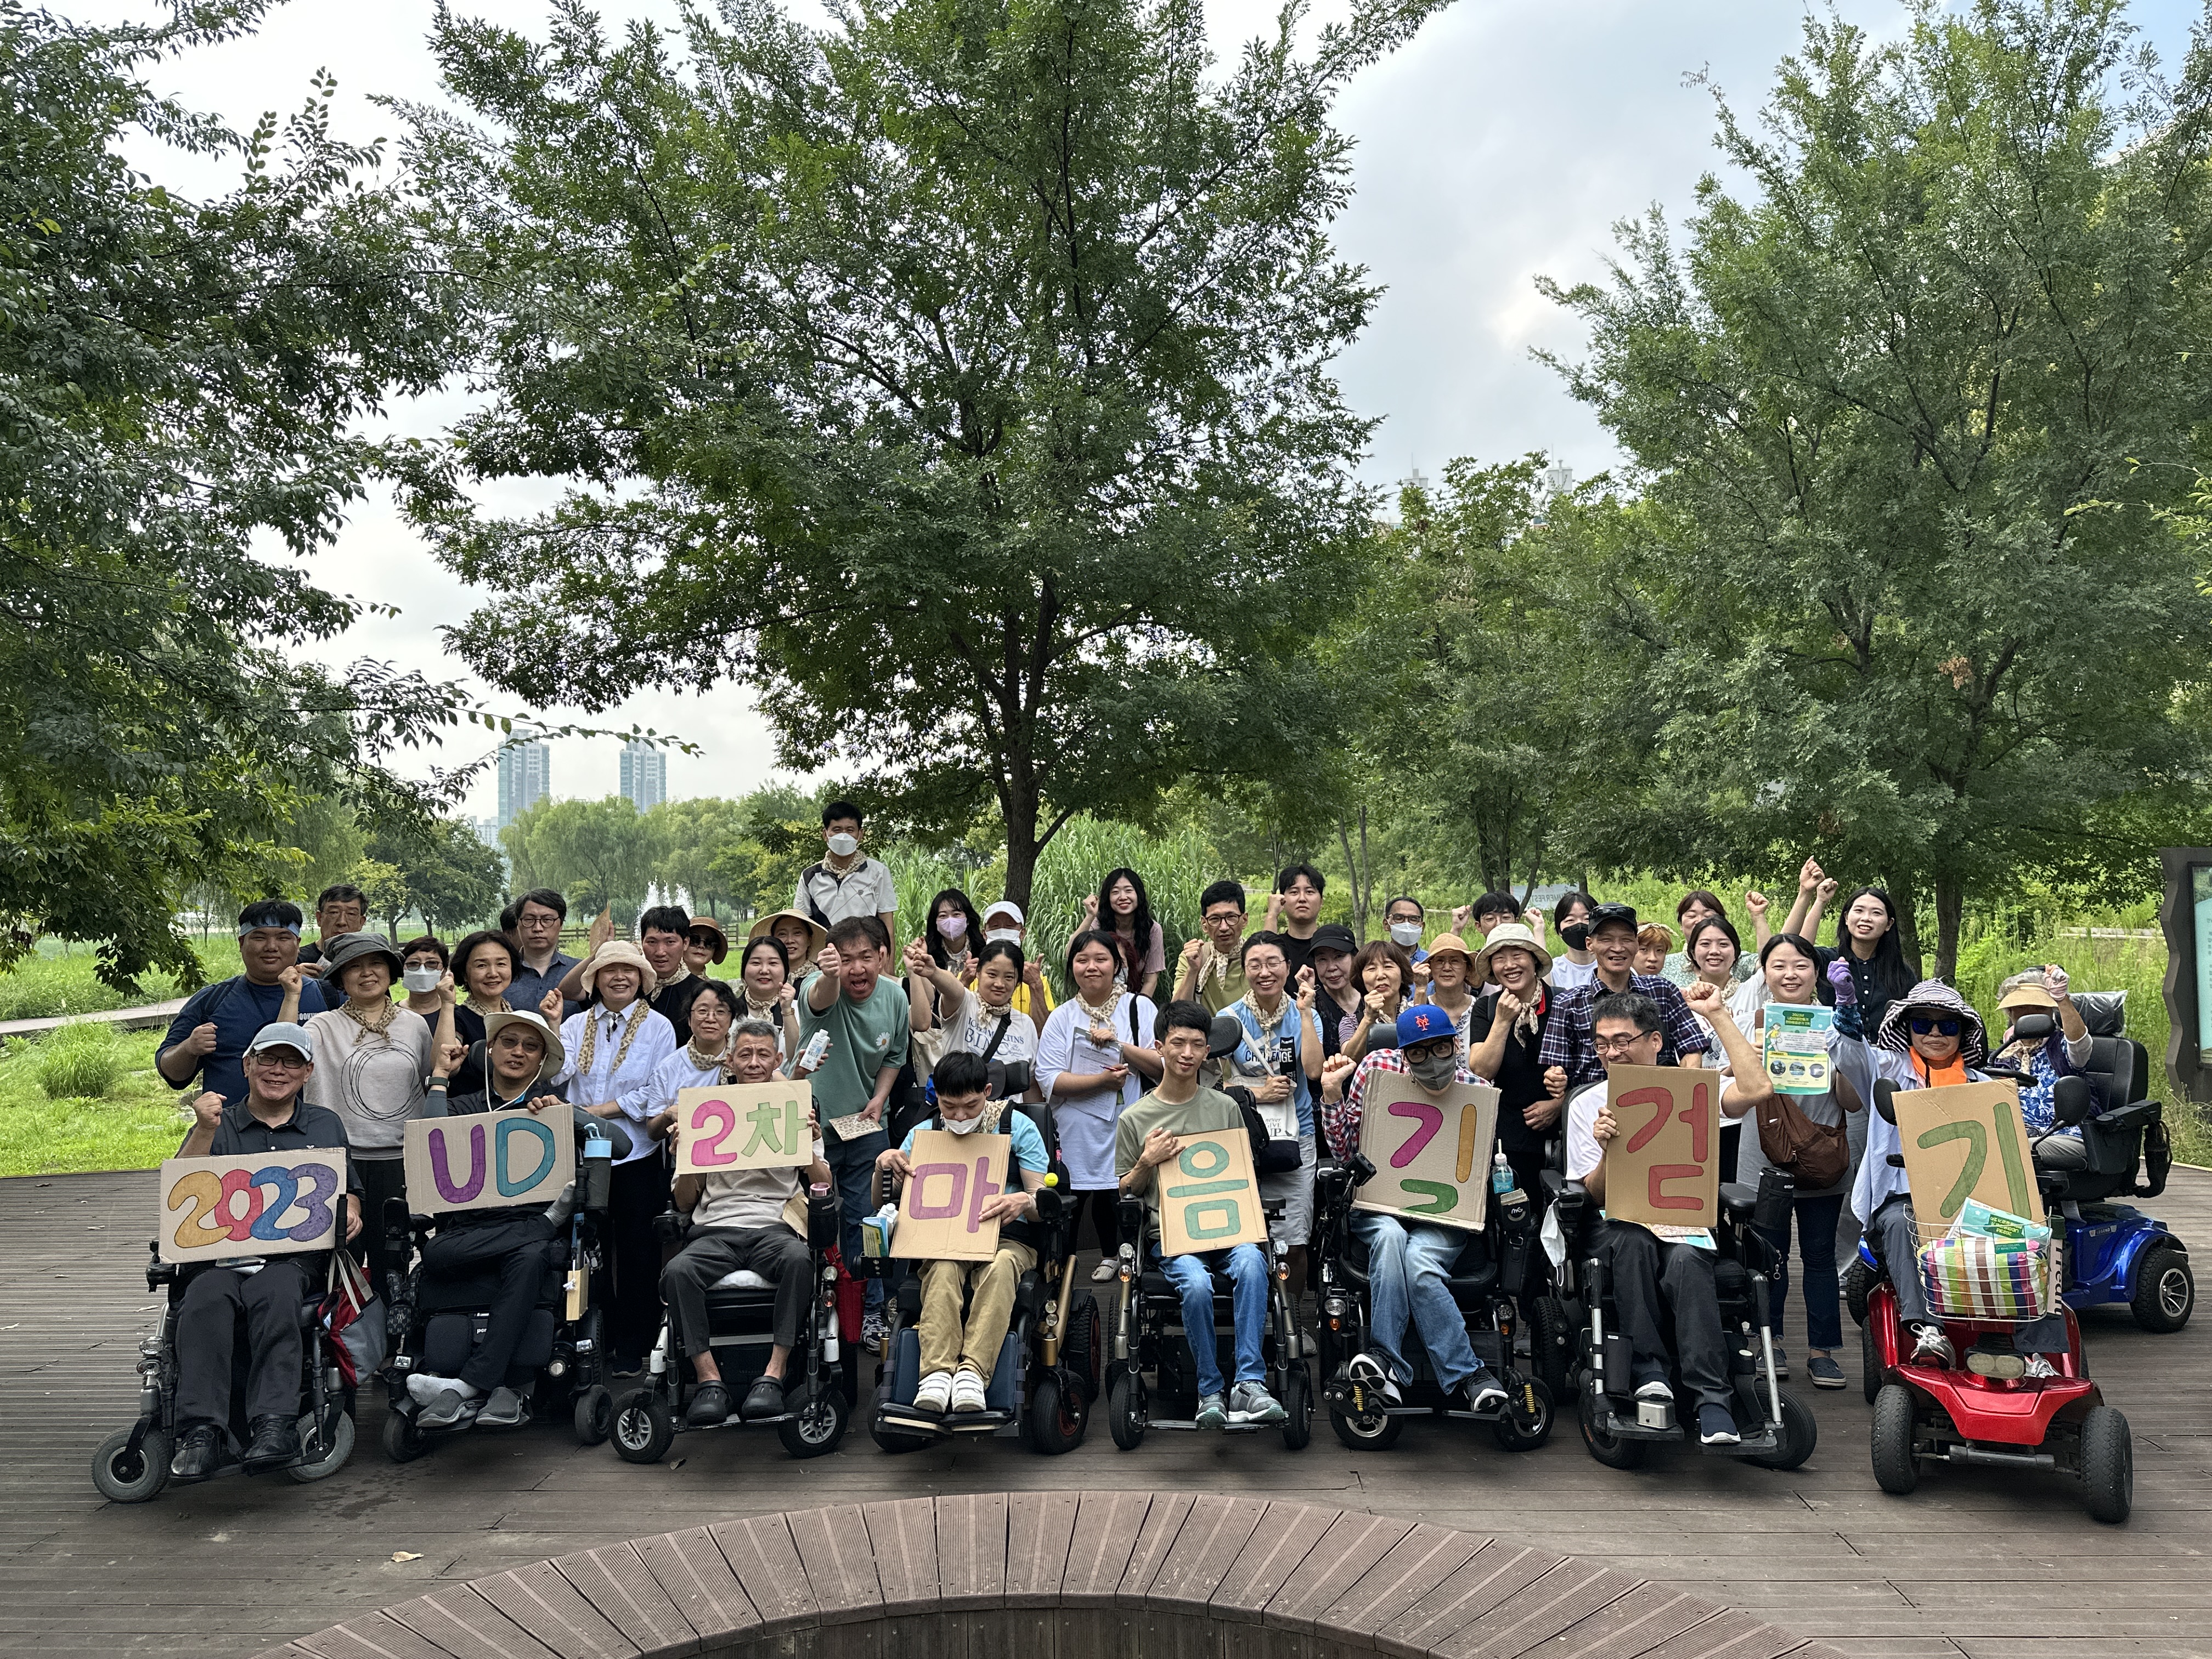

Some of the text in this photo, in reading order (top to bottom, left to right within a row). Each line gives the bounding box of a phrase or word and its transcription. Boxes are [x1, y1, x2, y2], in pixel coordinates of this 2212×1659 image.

[1245, 1050, 1293, 1063] CHLENGE
[428, 1117, 556, 1204] UD
[691, 1099, 808, 1167] 2차
[1387, 1101, 1477, 1217] 길
[1616, 1082, 1708, 1211] 걷
[1917, 1102, 2032, 1220] 기
[168, 1163, 337, 1249] 2023
[909, 1156, 1000, 1233] 마
[1166, 1141, 1249, 1240] 음
